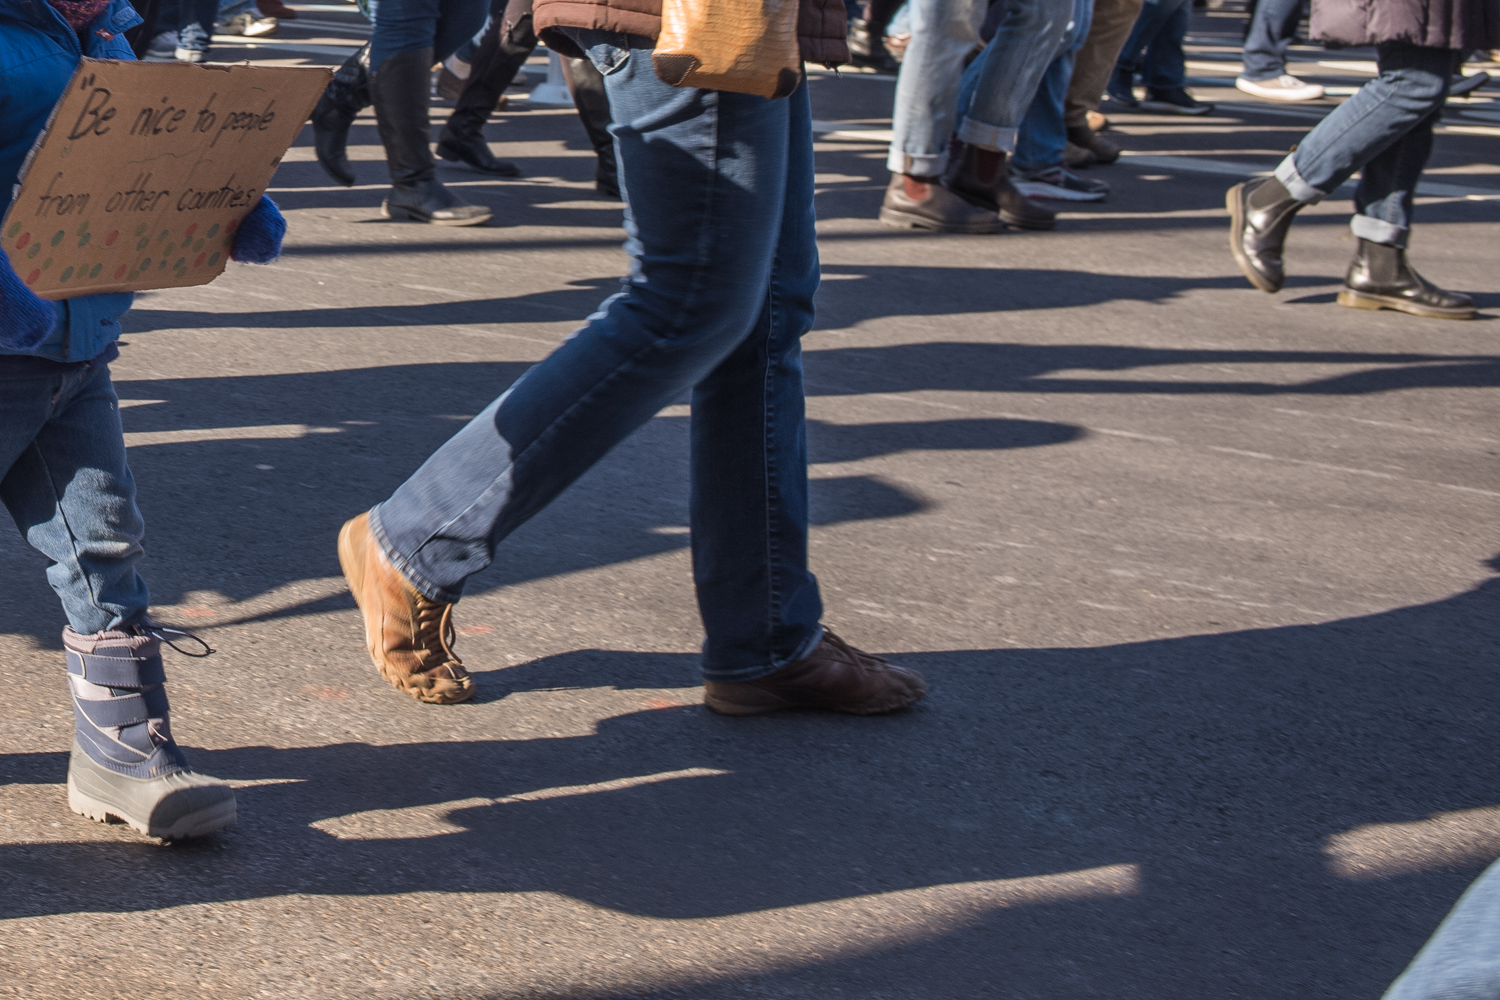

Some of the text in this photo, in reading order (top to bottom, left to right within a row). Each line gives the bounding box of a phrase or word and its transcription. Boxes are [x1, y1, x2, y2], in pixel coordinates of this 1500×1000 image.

[130, 96, 187, 137] nice
[192, 92, 217, 133] to
[209, 99, 276, 148] people
[35, 171, 91, 217] from
[104, 172, 170, 213] other
